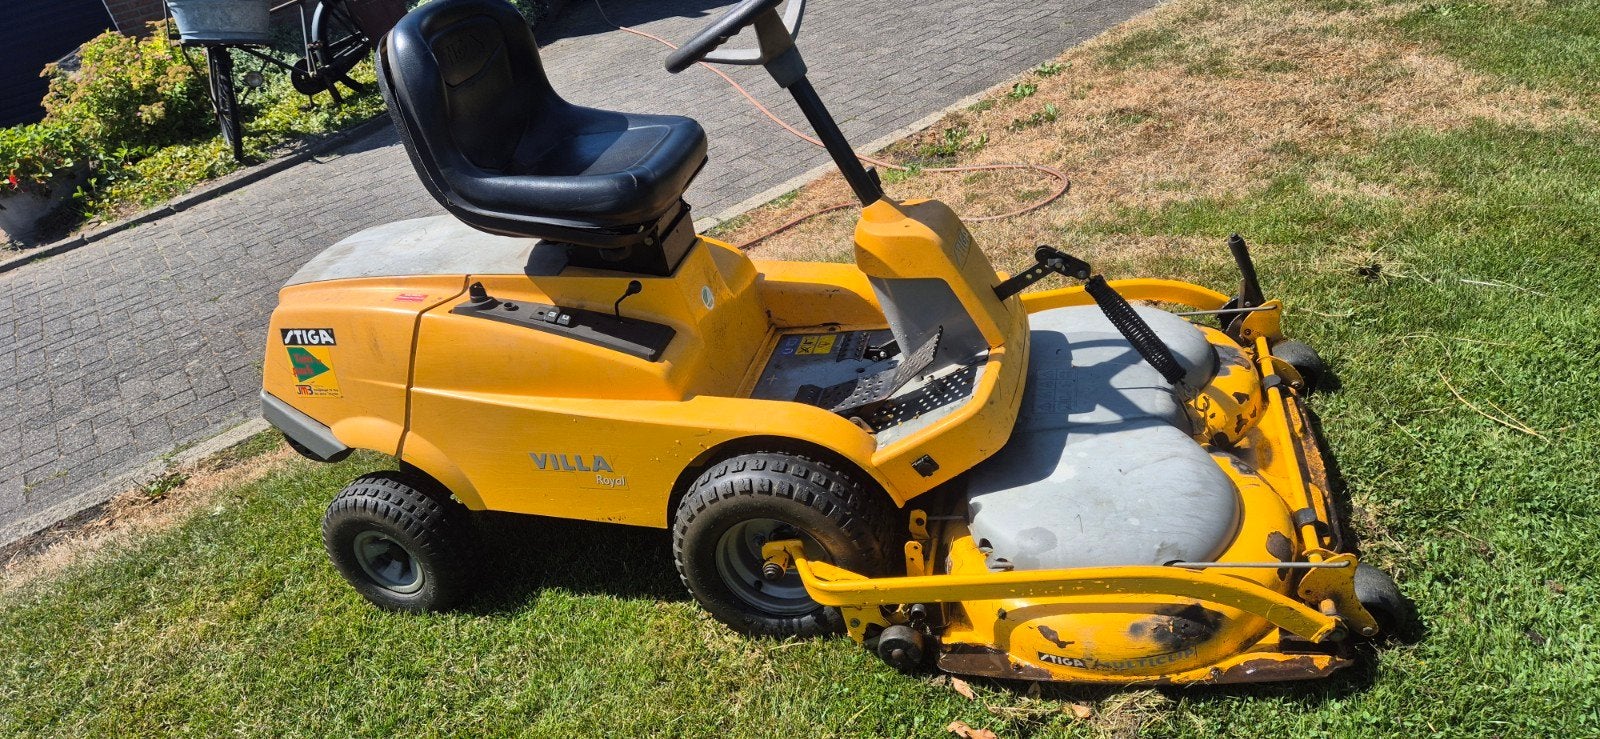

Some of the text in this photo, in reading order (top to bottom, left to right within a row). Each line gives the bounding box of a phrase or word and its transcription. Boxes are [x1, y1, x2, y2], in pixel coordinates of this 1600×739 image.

[284, 329, 334, 345] STIGA
[529, 452, 614, 473] VILLA
[596, 474, 626, 487] Royal
[1040, 653, 1085, 667] STIGA
